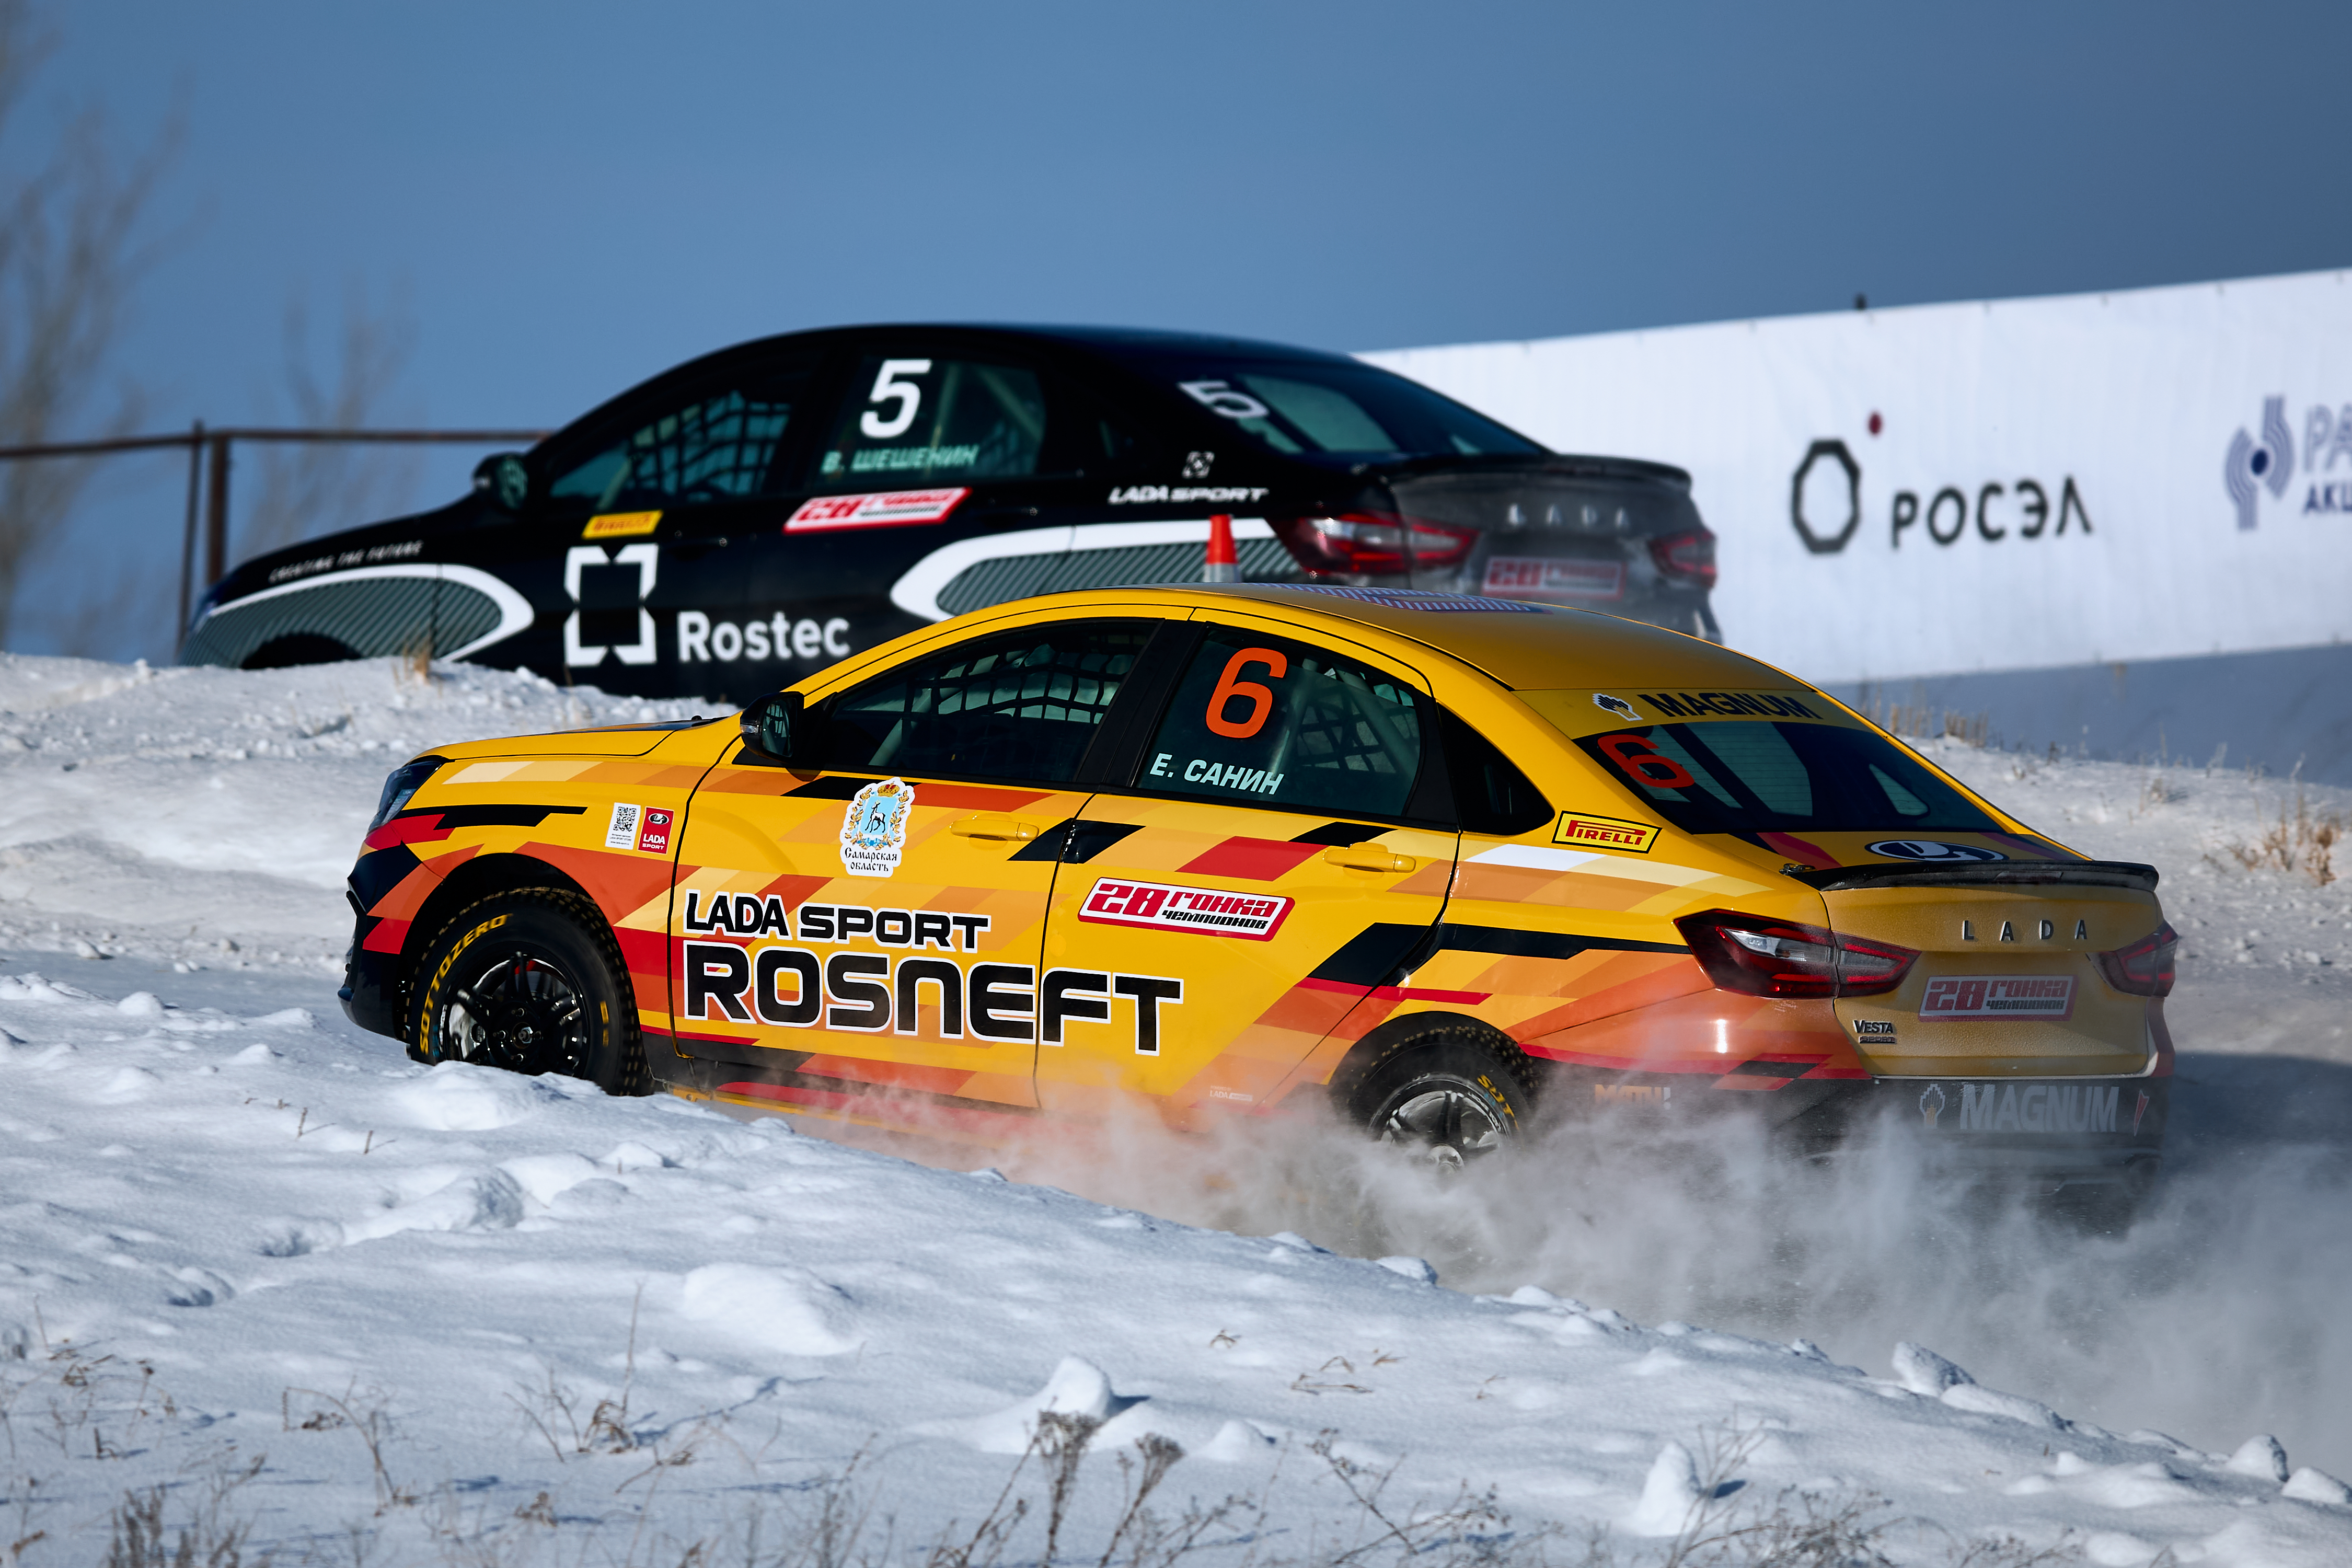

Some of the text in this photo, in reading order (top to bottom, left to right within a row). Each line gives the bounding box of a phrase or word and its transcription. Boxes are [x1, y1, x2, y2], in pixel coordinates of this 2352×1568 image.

[860, 358, 932, 439] 5
[1177, 379, 1269, 419] 5
[850, 444, 980, 472] ШЕШЕНИН
[1108, 485, 1270, 505] LADA SPORT
[1892, 474, 2093, 550] РОСЭЛ
[337, 549, 365, 567] THE
[366, 539, 424, 561] FUTURE
[677, 609, 851, 663] Rostec
[1206, 648, 1287, 739] 6
[1636, 693, 1824, 720] MAGNUM
[1150, 753, 1284, 794] Е. САНИН
[1597, 734, 1695, 788] 6
[643, 833, 665, 845] LADA
[1565, 820, 1647, 845] PIRELLI
[845, 847, 897, 862] Самарская
[850, 862, 889, 871] область
[1087, 883, 1170, 918] 28
[685, 890, 990, 952] LADA SPORT
[1962, 919, 2088, 941] LADA
[420, 913, 509, 1055] SOTTOZERO
[684, 941, 1184, 1056] ROSNEFT
[1924, 981, 1989, 1011] 28
[1853, 1020, 1893, 1033] VESTA
[1209, 1090, 1228, 1099] LADA
[1959, 1084, 2119, 1133] MAGNUM
